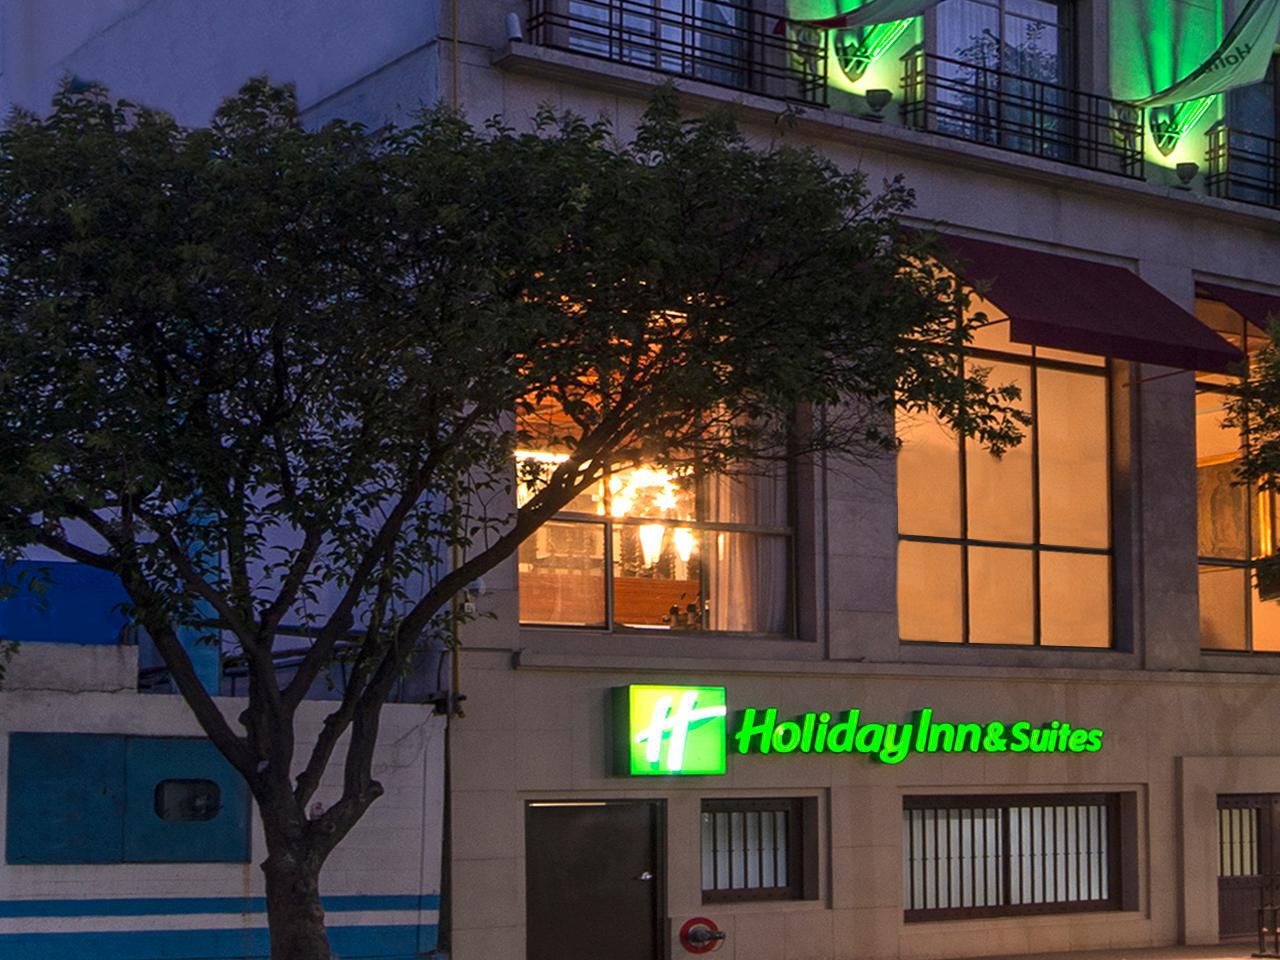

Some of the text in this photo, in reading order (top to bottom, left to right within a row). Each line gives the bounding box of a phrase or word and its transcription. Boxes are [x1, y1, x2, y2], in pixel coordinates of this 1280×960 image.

[735, 707, 1104, 764] Holiday Inn & Suites
